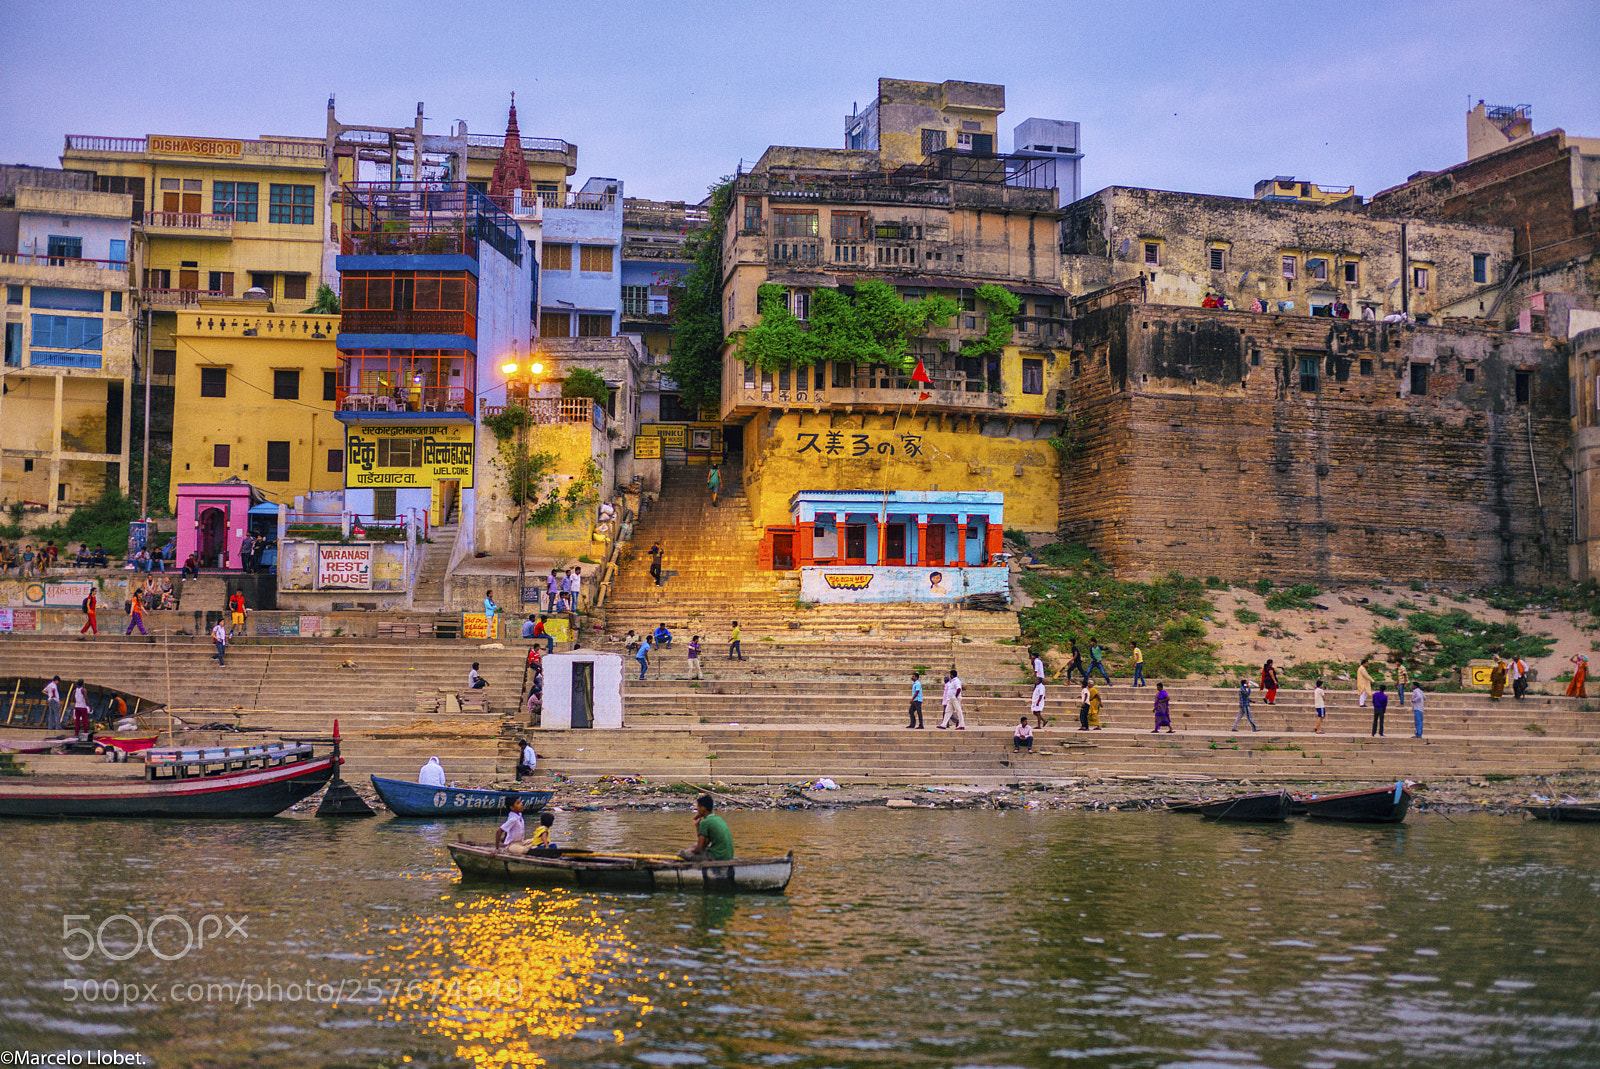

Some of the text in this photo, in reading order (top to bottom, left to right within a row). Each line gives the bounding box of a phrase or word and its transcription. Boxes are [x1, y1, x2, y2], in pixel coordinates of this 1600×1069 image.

[152, 139, 240, 155] DISHA SCHOOL
[321, 550, 369, 560] VARANASI
[326, 562, 363, 571] REST
[321, 573, 368, 583] HOUSE
[454, 793, 496, 809] State
